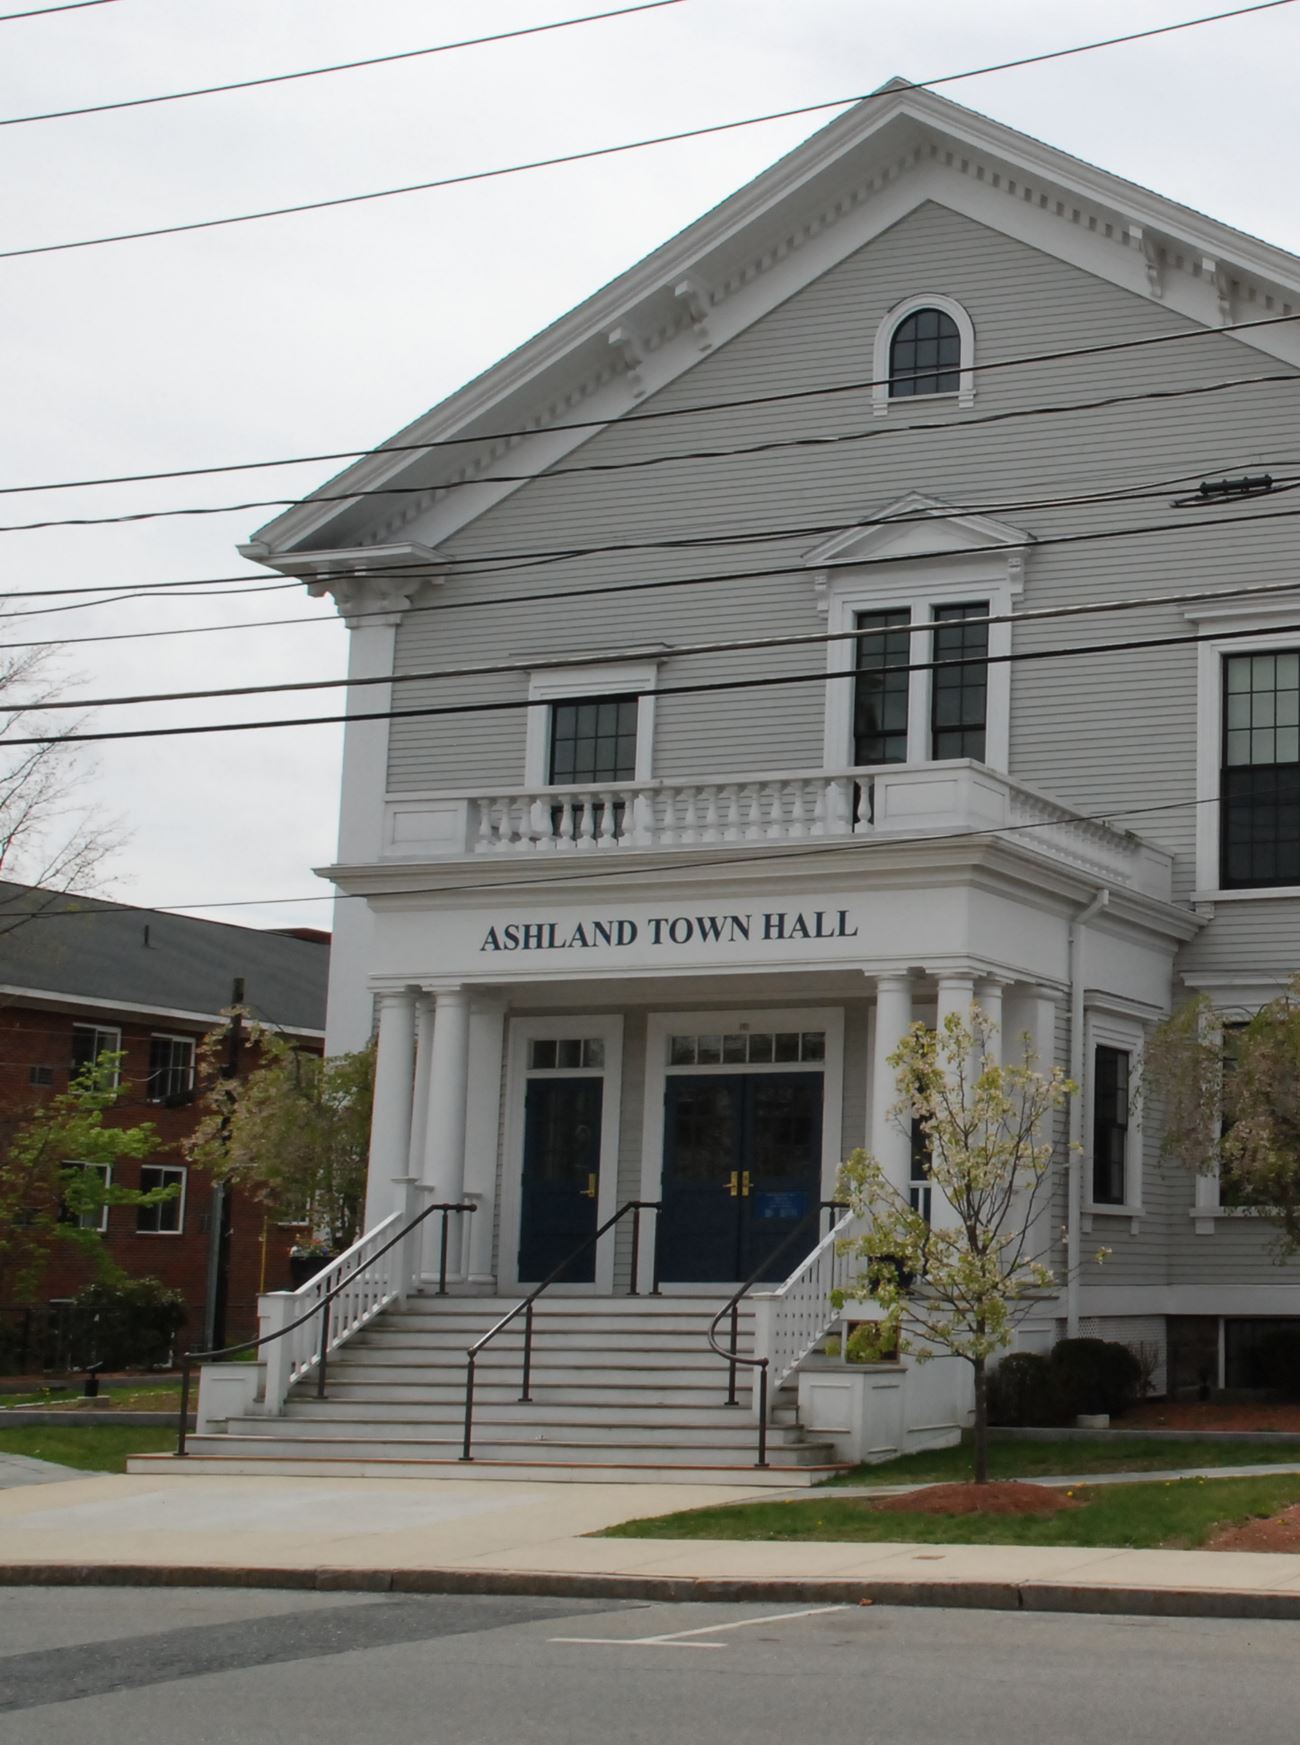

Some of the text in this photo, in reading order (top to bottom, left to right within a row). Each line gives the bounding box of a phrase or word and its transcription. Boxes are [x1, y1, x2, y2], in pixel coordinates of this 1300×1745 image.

[480, 910, 859, 952] ASHLAND TOWN HALL
